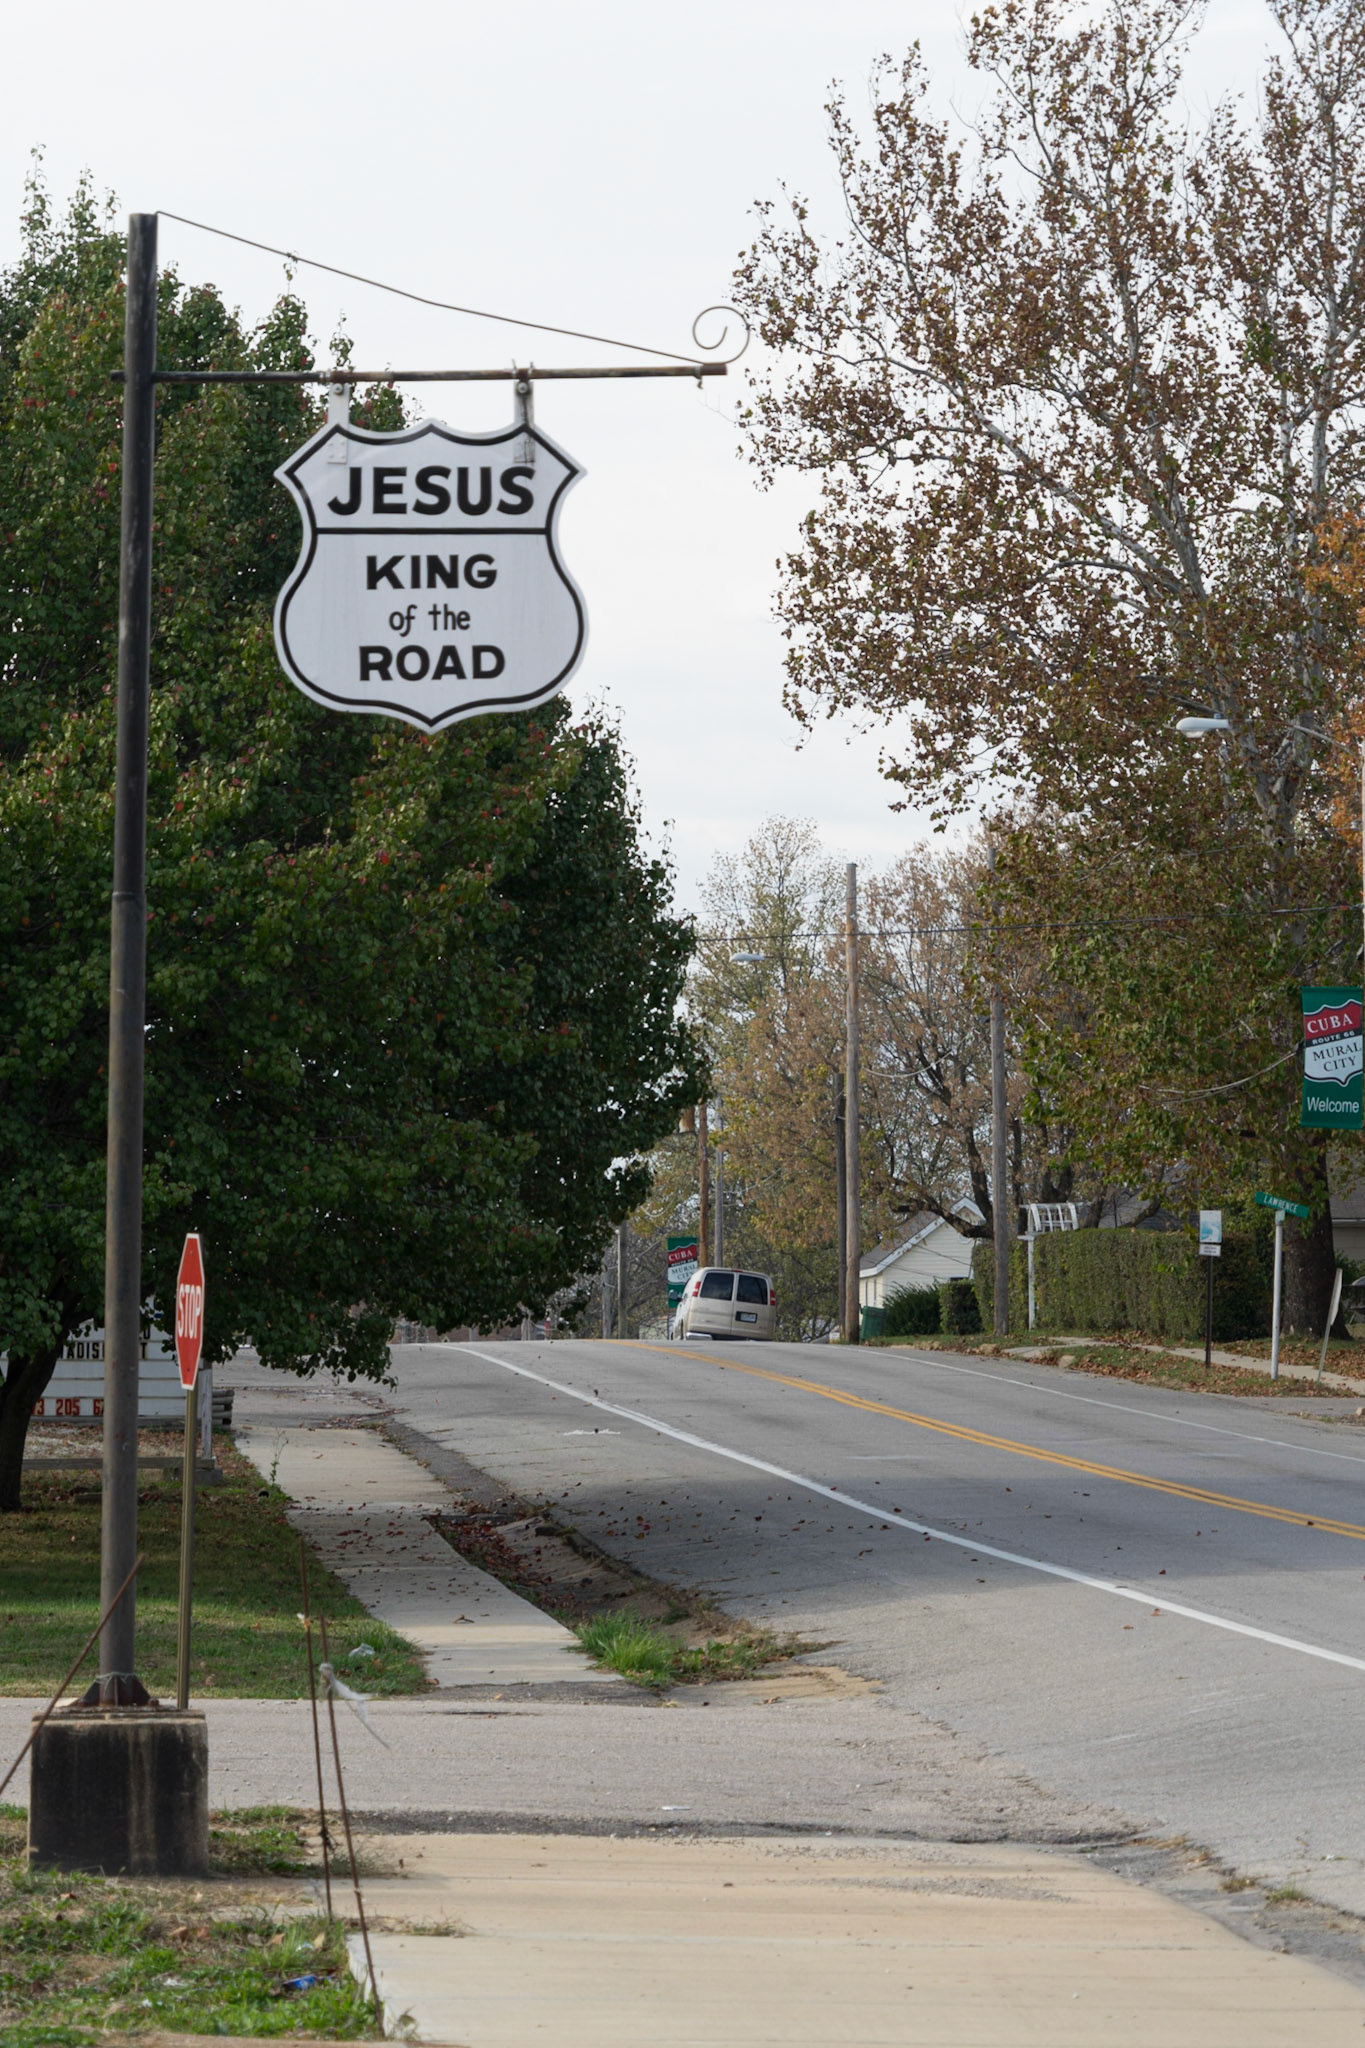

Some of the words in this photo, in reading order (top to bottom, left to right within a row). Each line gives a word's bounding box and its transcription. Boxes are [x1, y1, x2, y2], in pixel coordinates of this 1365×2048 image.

[327, 465, 536, 516] JESUS
[366, 554, 497, 590] KING
[389, 604, 418, 637] of
[428, 603, 471, 631] the
[359, 645, 506, 681] ROAD
[1306, 1013, 1353, 1034] CUBA
[1312, 1034, 1341, 1045] ROUTE
[1343, 1030, 1355, 1038] 66
[1313, 1042, 1362, 1061] MURAL
[1323, 1056, 1357, 1072] CITY
[1306, 1096, 1360, 1114] Welcome
[1263, 1195, 1299, 1214] LAWRENCE
[668, 1249, 693, 1261] CUBA
[177, 1283, 201, 1339] STOP
[56, 1397, 80, 1416] 205
